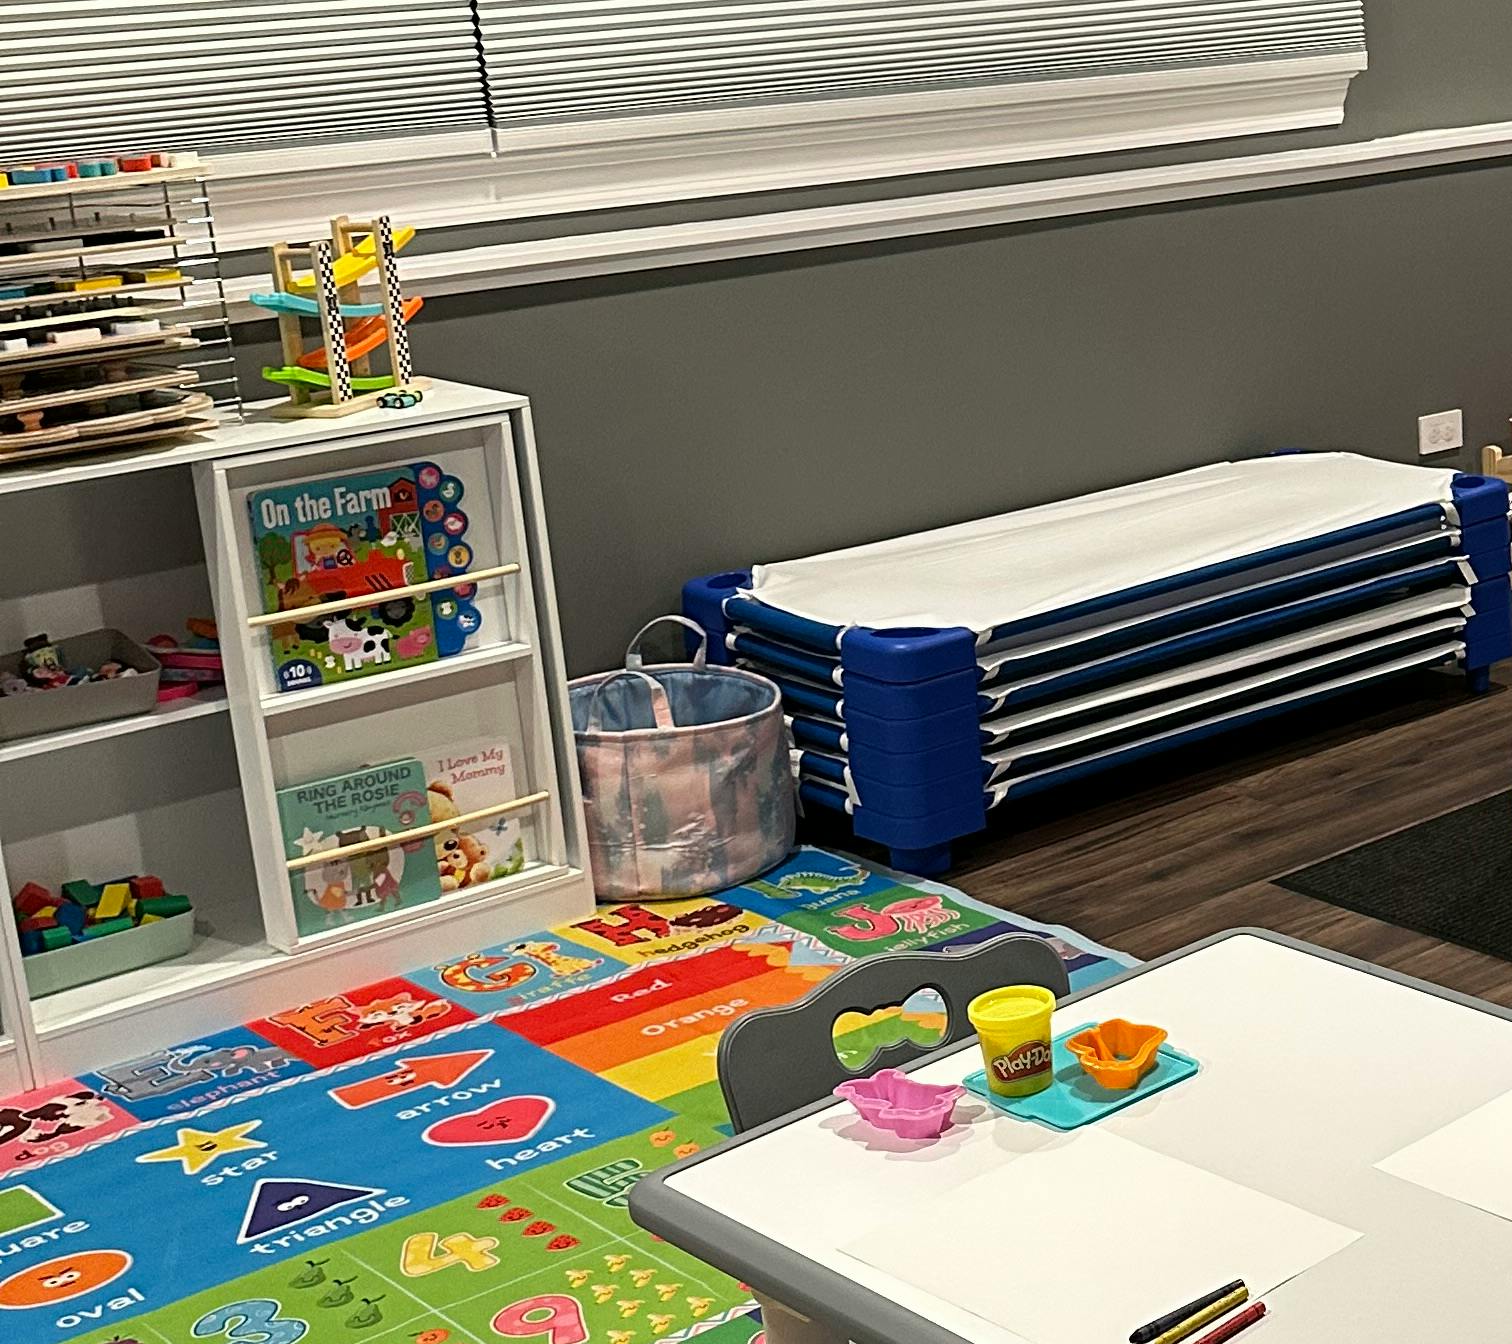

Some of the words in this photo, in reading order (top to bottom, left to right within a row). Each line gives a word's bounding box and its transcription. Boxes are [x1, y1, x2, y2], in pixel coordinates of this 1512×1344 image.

[261, 498, 291, 529] On
[295, 492, 331, 523] the
[334, 486, 393, 516] Farm
[289, 664, 305, 678] 10
[438, 760, 444, 773] I
[447, 754, 477, 770] Love
[481, 748, 504, 763] My
[450, 764, 506, 784] Mommy
[297, 785, 337, 804] RING
[342, 766, 411, 793] AROUND
[313, 795, 347, 814] THE
[351, 784, 400, 808] ROSIE
[570, 904, 672, 947] H
[637, 924, 750, 957] hedgehog
[824, 903, 901, 941] J
[437, 955, 537, 992] G
[609, 979, 673, 1004] Red
[266, 996, 361, 1048] F
[641, 997, 750, 1037] Orange
[96, 1052, 217, 1102] E
[167, 1070, 281, 1111] elephant
[395, 1079, 502, 1120] arrow
[15, 1142, 70, 1161] dog
[485, 1128, 596, 1170] heart
[201, 1151, 278, 1186] star
[0, 1220, 90, 1256] uare
[250, 1196, 411, 1255] triangle
[400, 1232, 500, 1277] 4
[56, 1288, 144, 1328] oval
